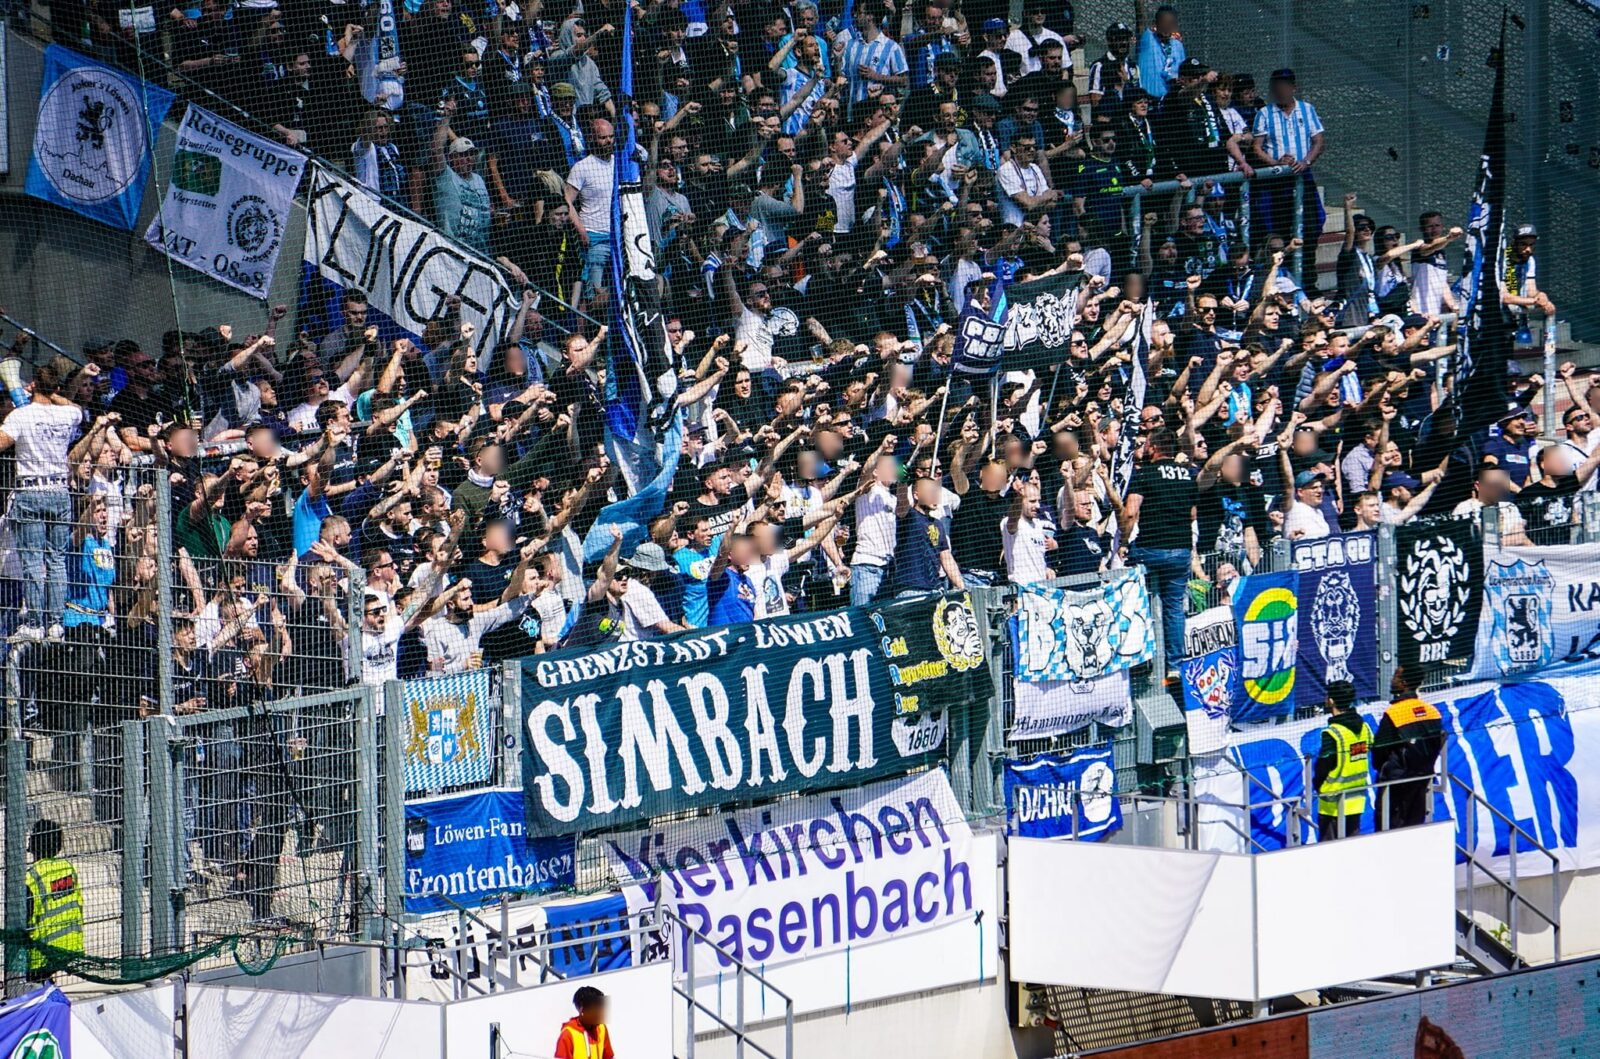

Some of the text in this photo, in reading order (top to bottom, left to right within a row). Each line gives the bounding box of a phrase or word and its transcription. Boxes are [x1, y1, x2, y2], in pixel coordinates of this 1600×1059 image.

[187, 109, 299, 176] Reisegruppe
[63, 168, 95, 189] Dachau
[1157, 465, 1192, 480] 1312
[536, 629, 731, 688] GRENZSTADT
[888, 660, 949, 687] Augustiner
[527, 648, 879, 823] SIMBACH
[908, 726, 939, 752] 1860
[605, 796, 952, 903] Vierkirchen
[677, 848, 973, 974] Pasenbach
